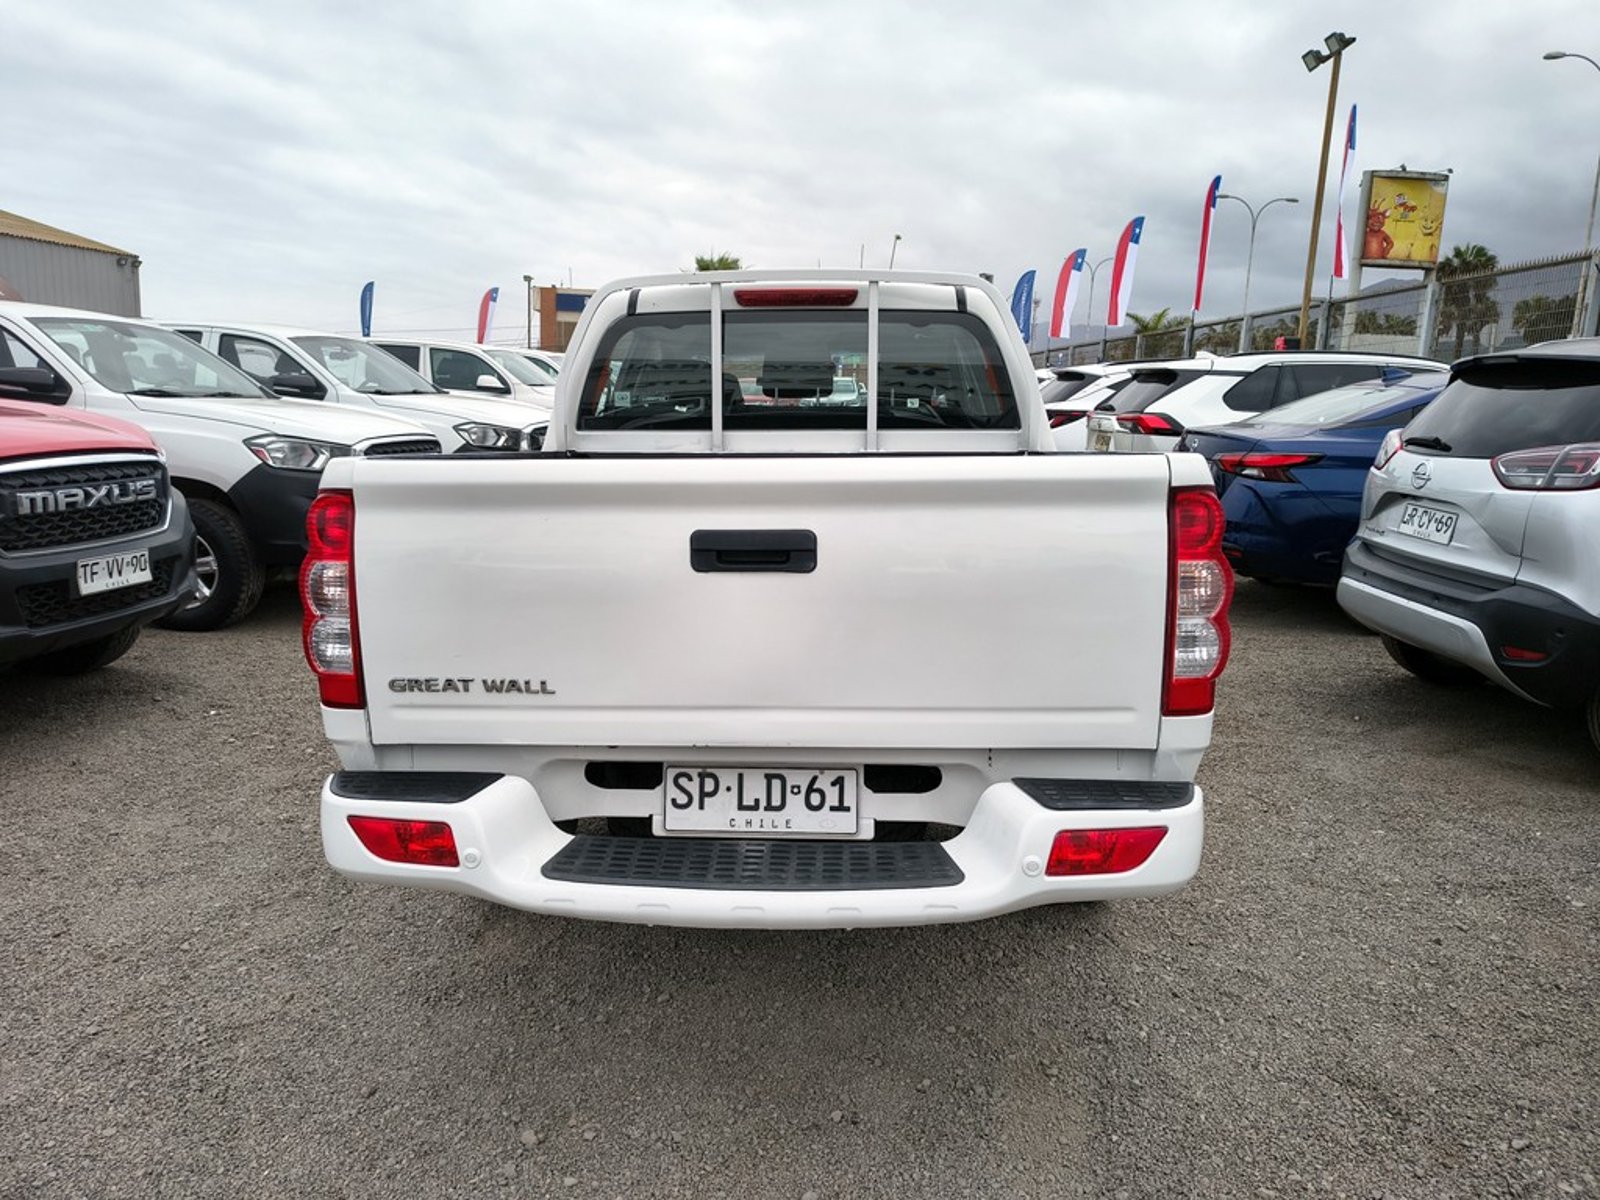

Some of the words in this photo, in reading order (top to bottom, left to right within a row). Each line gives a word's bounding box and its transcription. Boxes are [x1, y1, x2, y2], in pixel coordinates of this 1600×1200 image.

[17, 480, 157, 515] MAXUS
[388, 678, 475, 693] GREAT
[482, 678, 556, 695] WALL
[729, 818, 792, 829] CHILE
